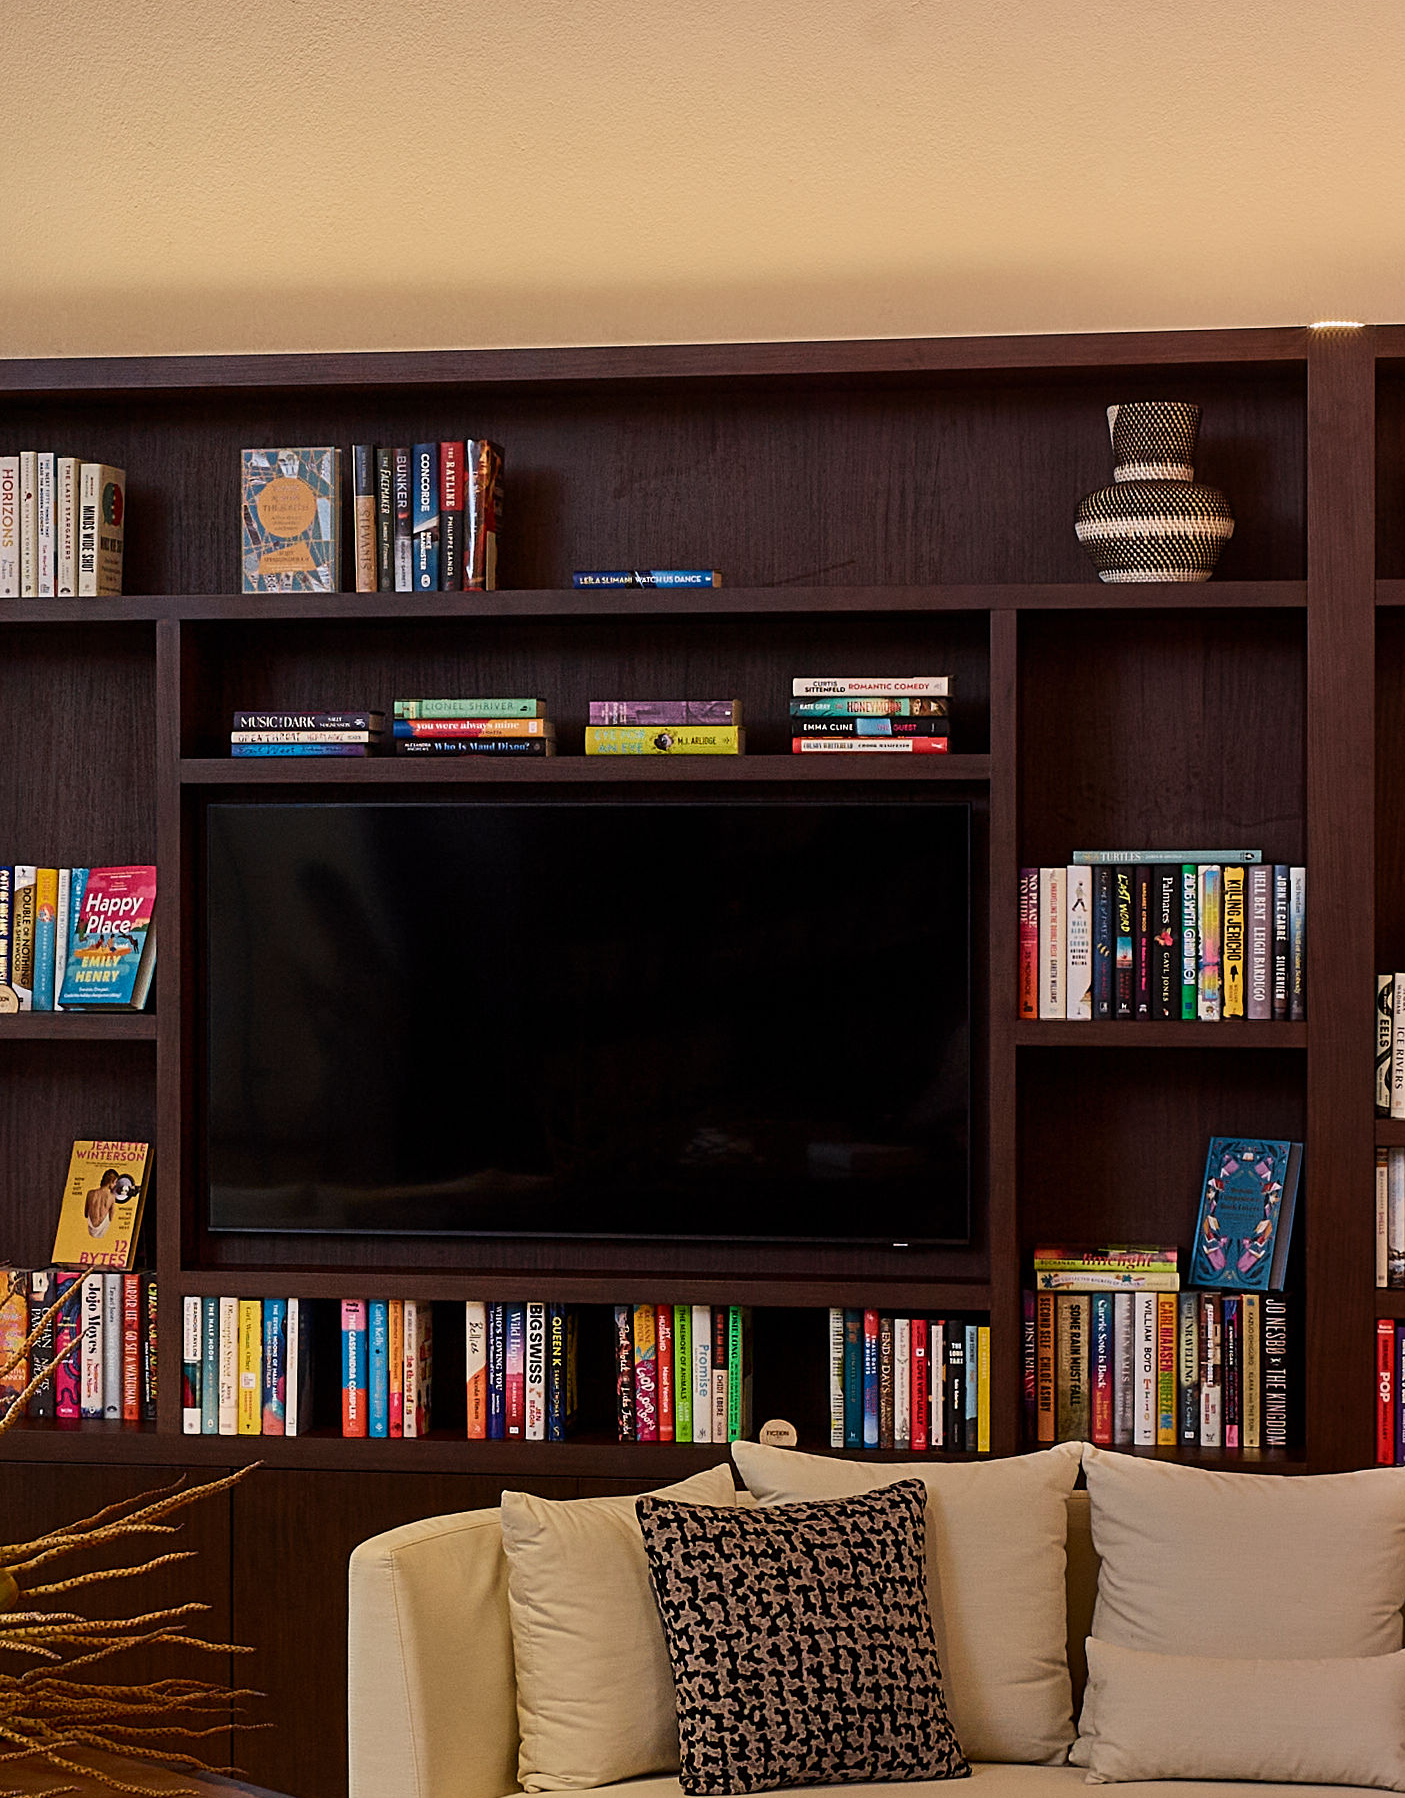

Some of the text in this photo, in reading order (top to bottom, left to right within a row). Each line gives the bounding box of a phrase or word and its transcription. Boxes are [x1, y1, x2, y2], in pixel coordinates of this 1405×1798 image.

[396, 455, 407, 508] BUNKER
[420, 453, 430, 513] CONCORDE
[2, 469, 14, 548] HORIZONS
[82, 505, 95, 573] MINDS WIDE SHUT
[848, 682, 930, 691] ROMANTIC COMEDY
[425, 701, 513, 710] LIONEL SHRIVER
[241, 716, 278, 728] MUSIC
[284, 716, 315, 728] DARK
[416, 723, 433, 732] you
[460, 721, 494, 732] always
[496, 722, 519, 730] mine
[1101, 852, 1141, 861] TURTLES
[86, 893, 144, 916] Happy
[1118, 874, 1131, 933] LAST WORD
[1162, 877, 1173, 924] Palmares
[86, 915, 132, 934] Place
[1226, 879, 1241, 961] KILLING JERICHO
[1253, 871, 1266, 1001] HELL BENT LEIGH BARDUGO
[81, 956, 122, 967] EMILY
[75, 970, 120, 983] HENRY
[1379, 1019, 1390, 1048] EELS
[1395, 1026, 1405, 1089] ICE RIVERS
[76, 1150, 145, 1162] WINTERSON
[90, 1141, 147, 1152] JEANETTE
[80, 1252, 127, 1267] BYTES
[115, 1240, 127, 1252] 12
[86, 1283, 100, 1354] Jojo Moyes
[1266, 1299, 1286, 1313] JO
[529, 1305, 542, 1384] BIG SWISS
[1144, 1299, 1152, 1372] WILLIAM BOYD
[1070, 1304, 1081, 1407] SOME RAIN MUST FALL
[699, 1344, 710, 1397] Promise
[1266, 1369, 1286, 1389] THE
[1380, 1372, 1390, 1402] POP
[1266, 1393, 1286, 1445] KINGDOM
